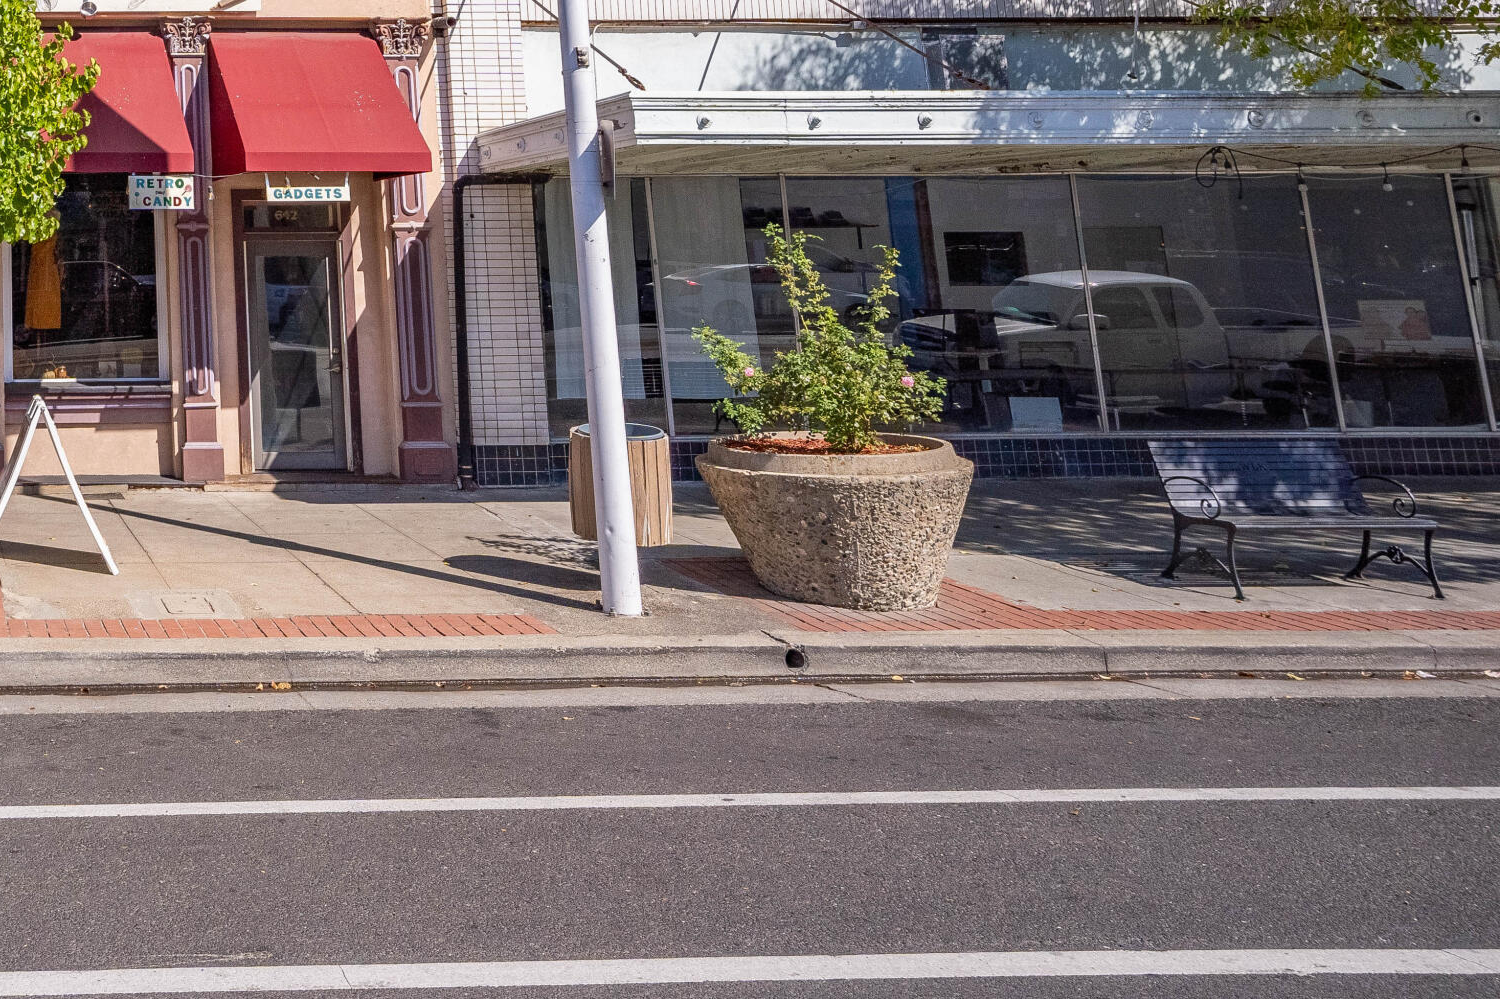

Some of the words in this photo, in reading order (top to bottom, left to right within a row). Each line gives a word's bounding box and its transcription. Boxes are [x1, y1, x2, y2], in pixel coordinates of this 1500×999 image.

[136, 178, 185, 188] RETRO
[273, 188, 343, 199] GADGETS
[143, 196, 192, 206] CANDY
